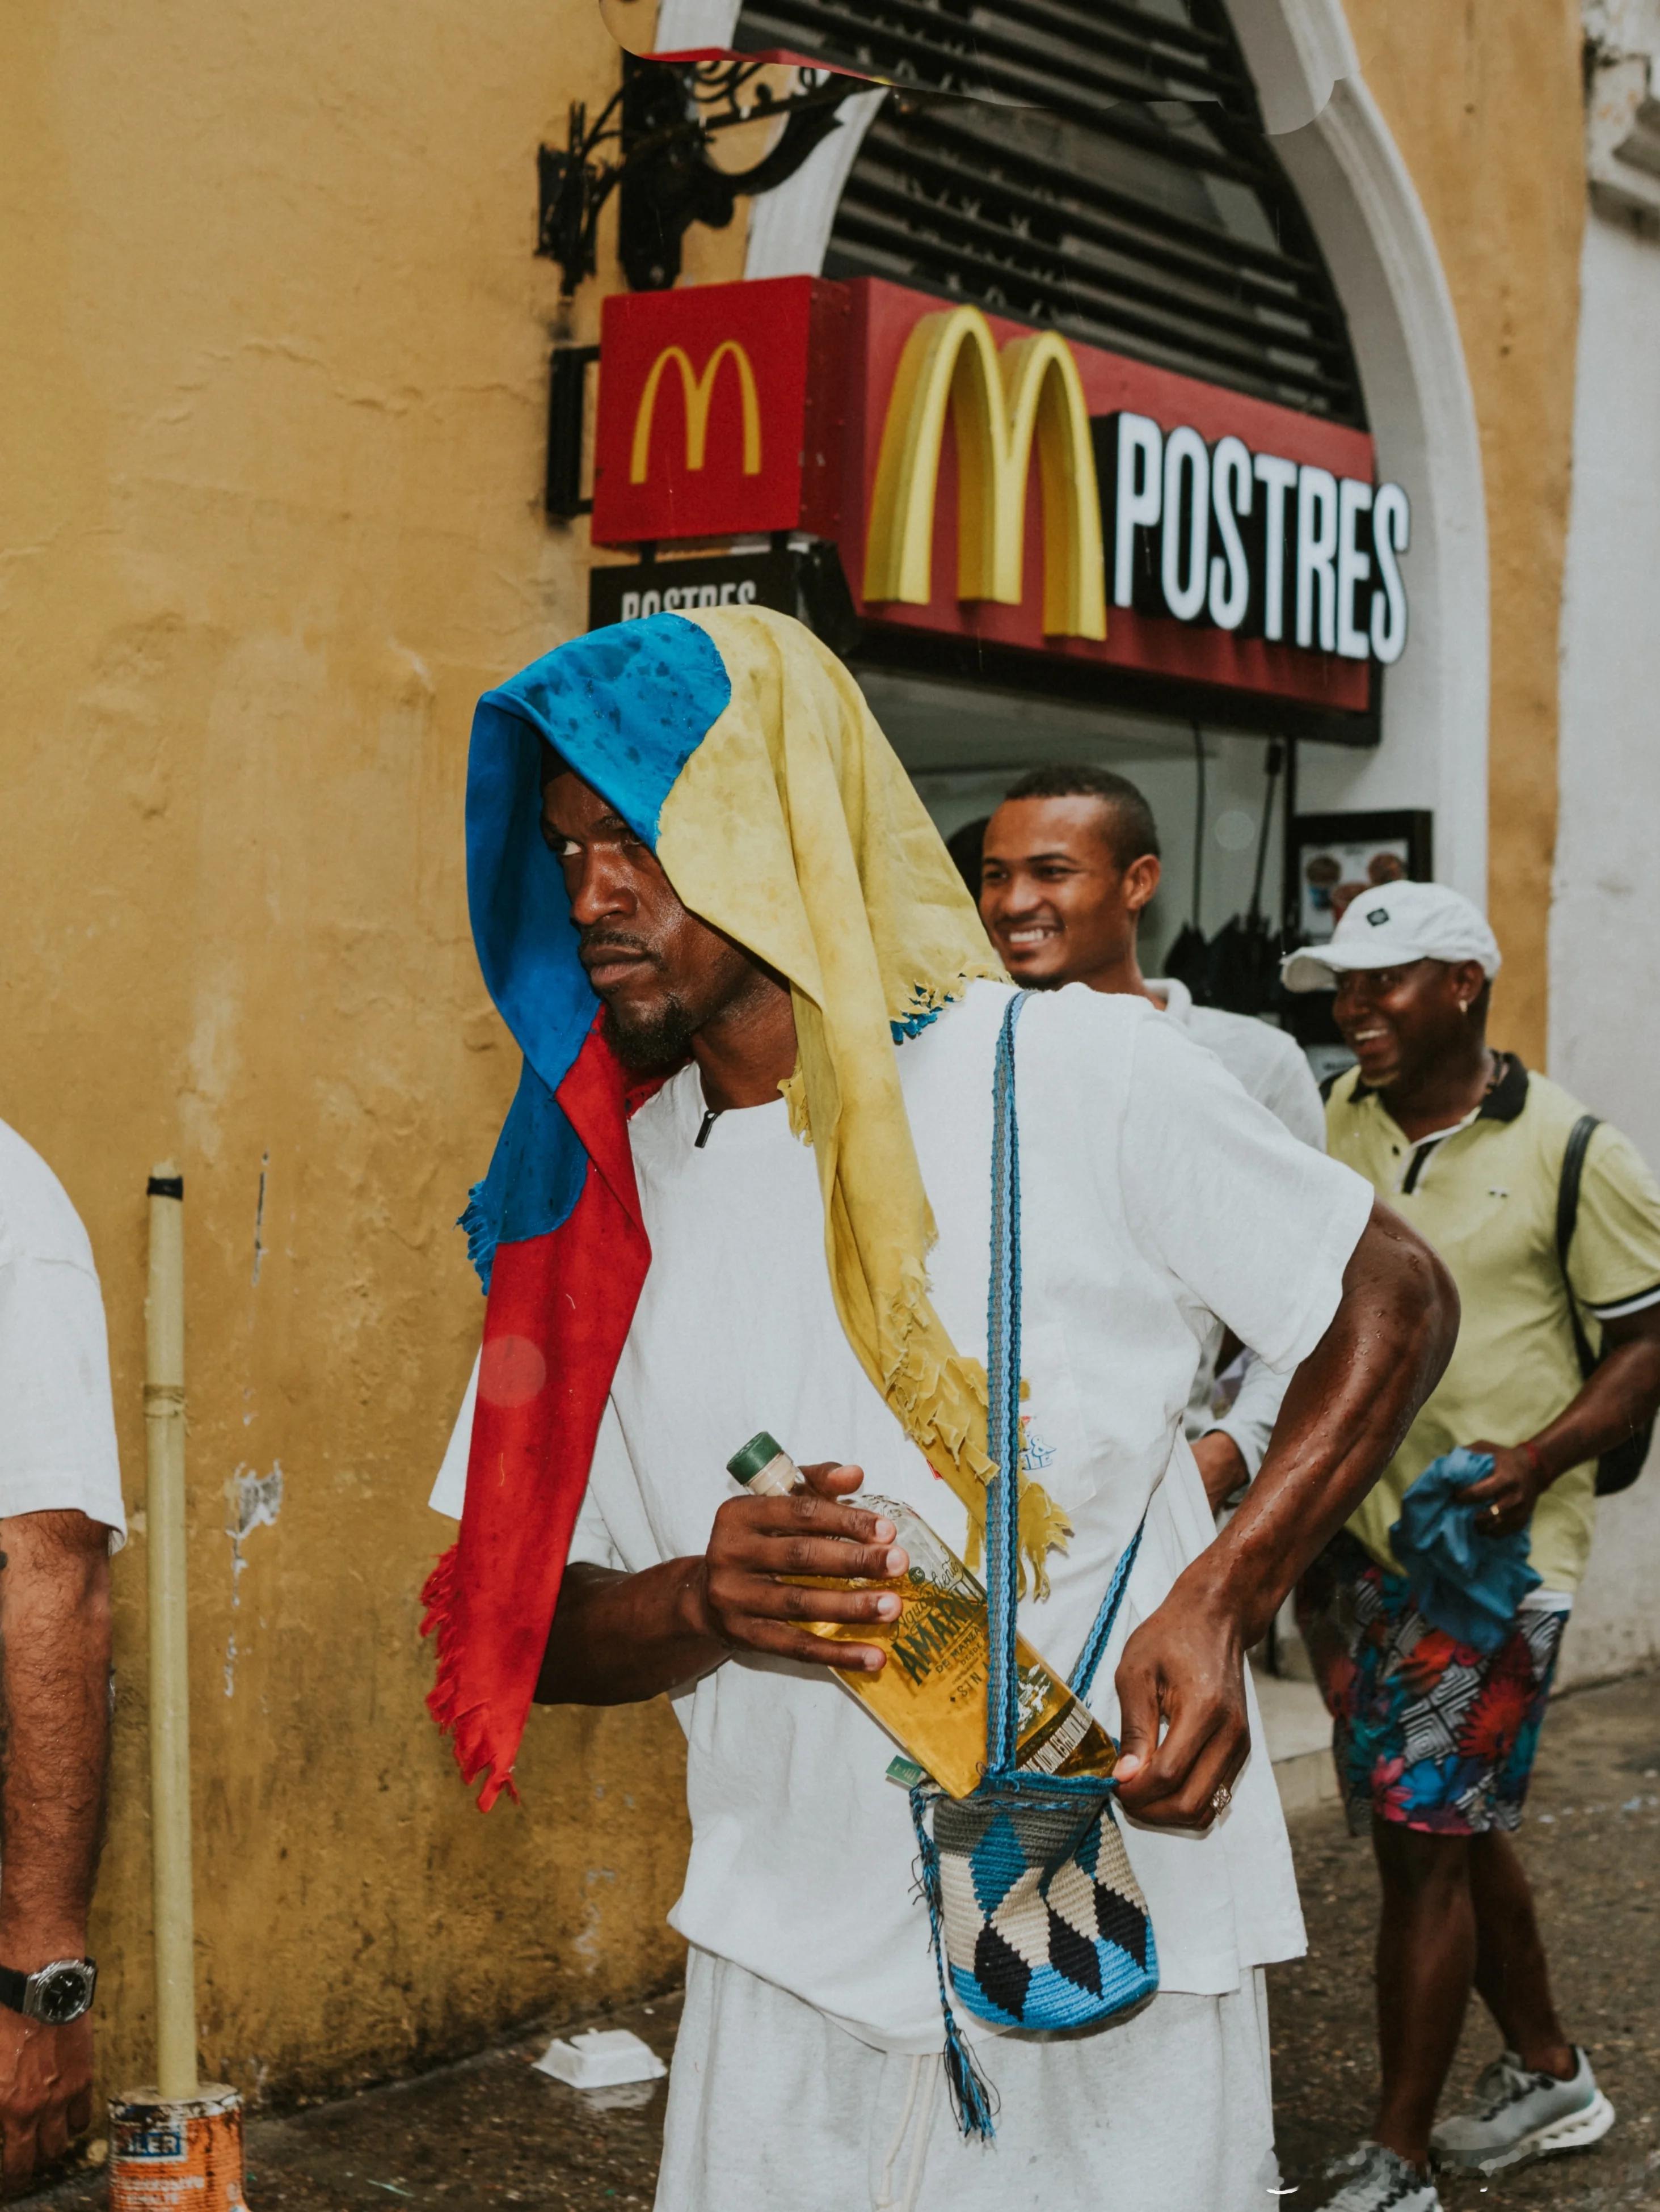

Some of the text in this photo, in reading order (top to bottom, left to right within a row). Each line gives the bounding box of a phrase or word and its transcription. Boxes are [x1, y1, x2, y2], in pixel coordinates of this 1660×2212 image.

[1114, 411, 1412, 664] POSTRES
[892, 1584, 987, 1686] AMARILL
[957, 1671, 983, 1698] SIN
